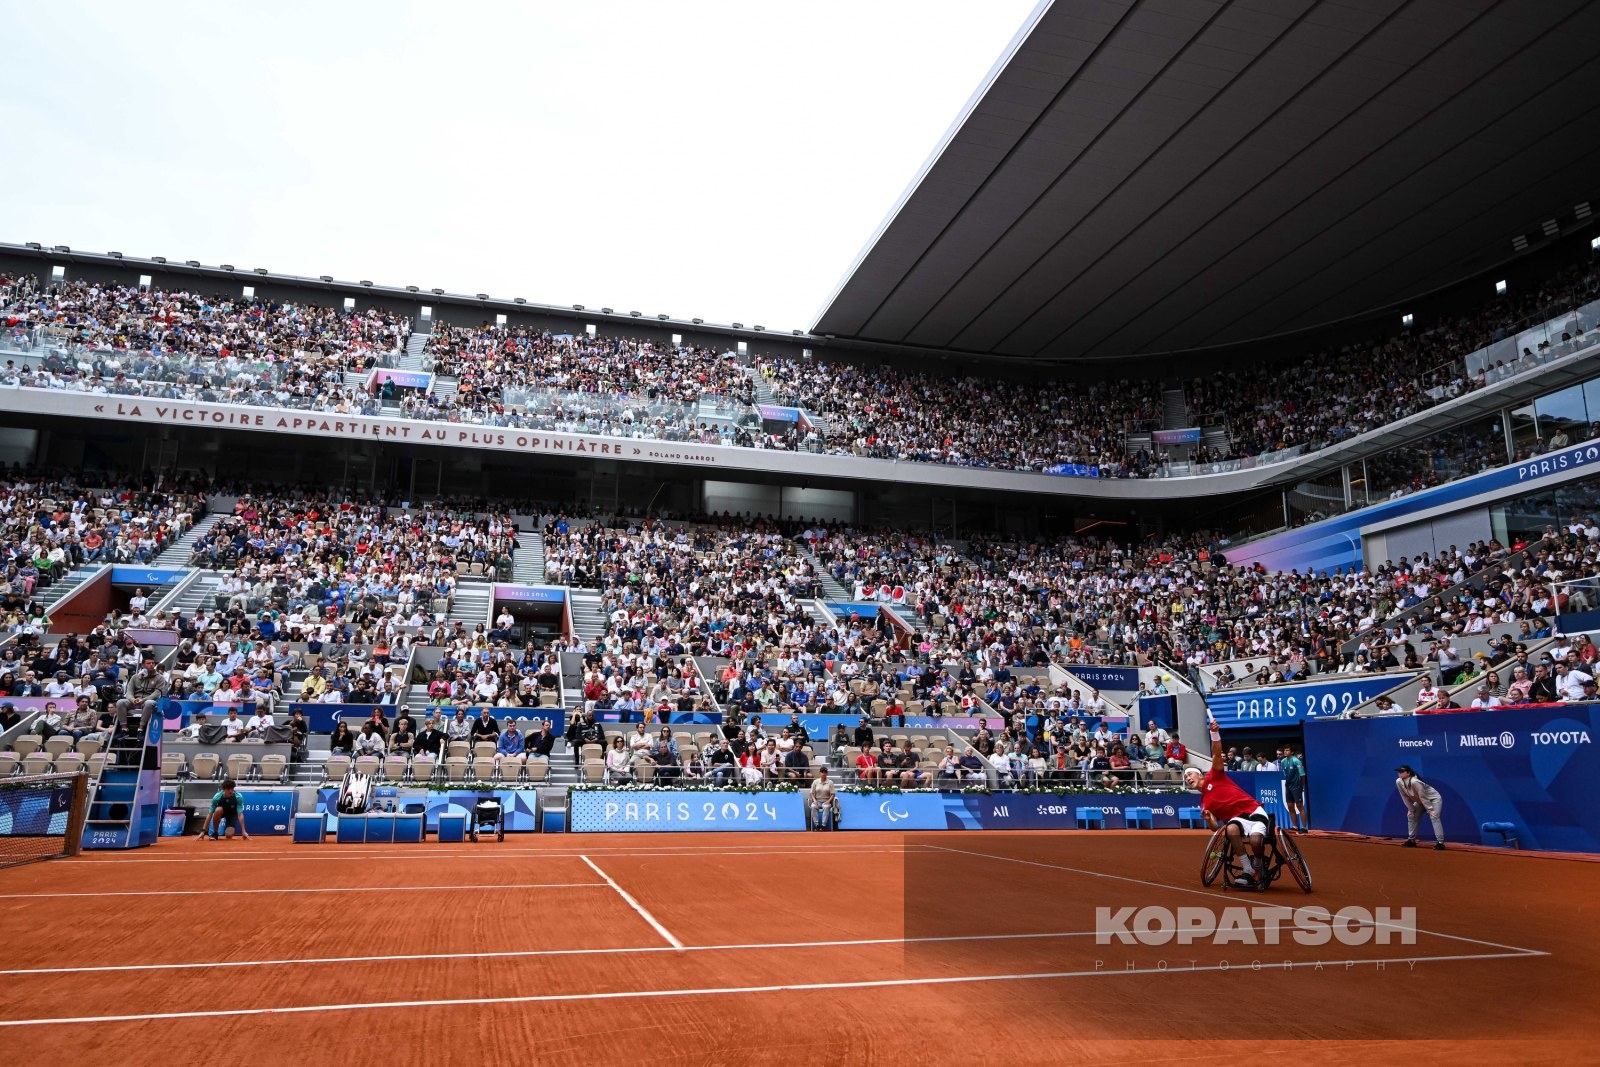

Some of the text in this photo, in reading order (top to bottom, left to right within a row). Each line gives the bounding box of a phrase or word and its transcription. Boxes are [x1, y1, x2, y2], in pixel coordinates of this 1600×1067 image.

[117, 403, 142, 416] LA
[156, 407, 264, 426] VICTOIRE
[276, 417, 411, 437] APPARTIENT
[421, 429, 447, 440] AU
[458, 431, 505, 445] PLUS
[516, 436, 622, 454] OPINIÂTRE
[649, 451, 681, 459] ROLAND
[684, 454, 715, 462] GARROS
[1102, 673, 1125, 681] 2024
[1459, 734, 1498, 747] Allianz
[1530, 731, 1592, 745] TOYOTA
[703, 802, 777, 821] 2024
